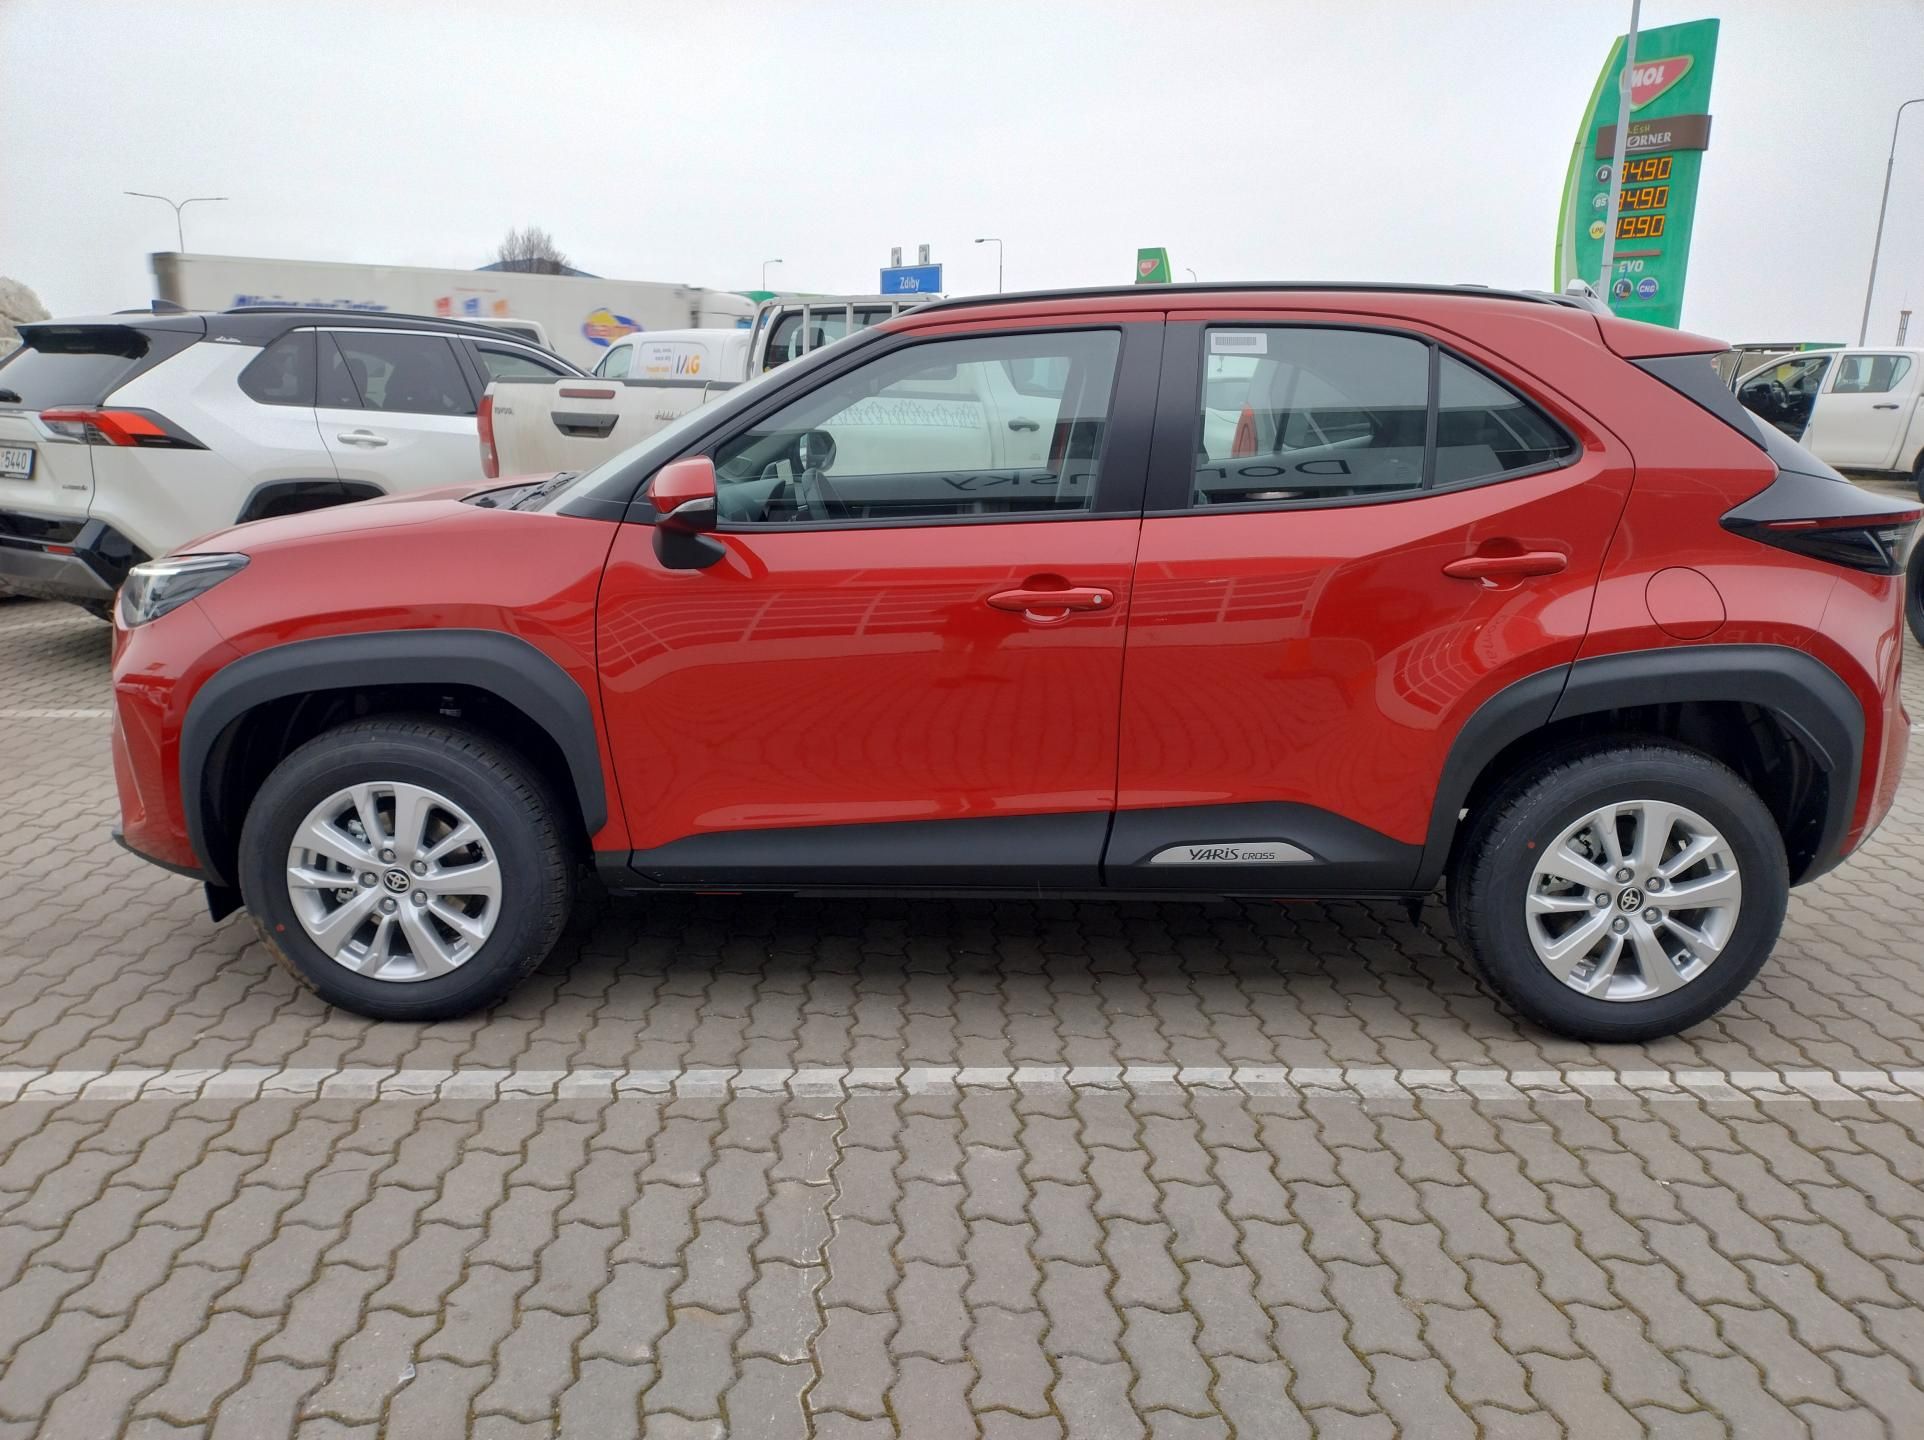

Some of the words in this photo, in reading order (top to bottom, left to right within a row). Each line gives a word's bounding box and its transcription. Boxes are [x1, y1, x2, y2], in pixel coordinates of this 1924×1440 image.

[1628, 124, 1650, 134] ESH
[1627, 132, 1671, 147] ORNER
[1600, 170, 1608, 179] D
[1618, 260, 1644, 273] EVO
[899, 276, 920, 291] Zdiby
[1639, 285, 1655, 293] CNG
[5, 450, 28, 470] 5440
[1241, 852, 1275, 860] CROSS
